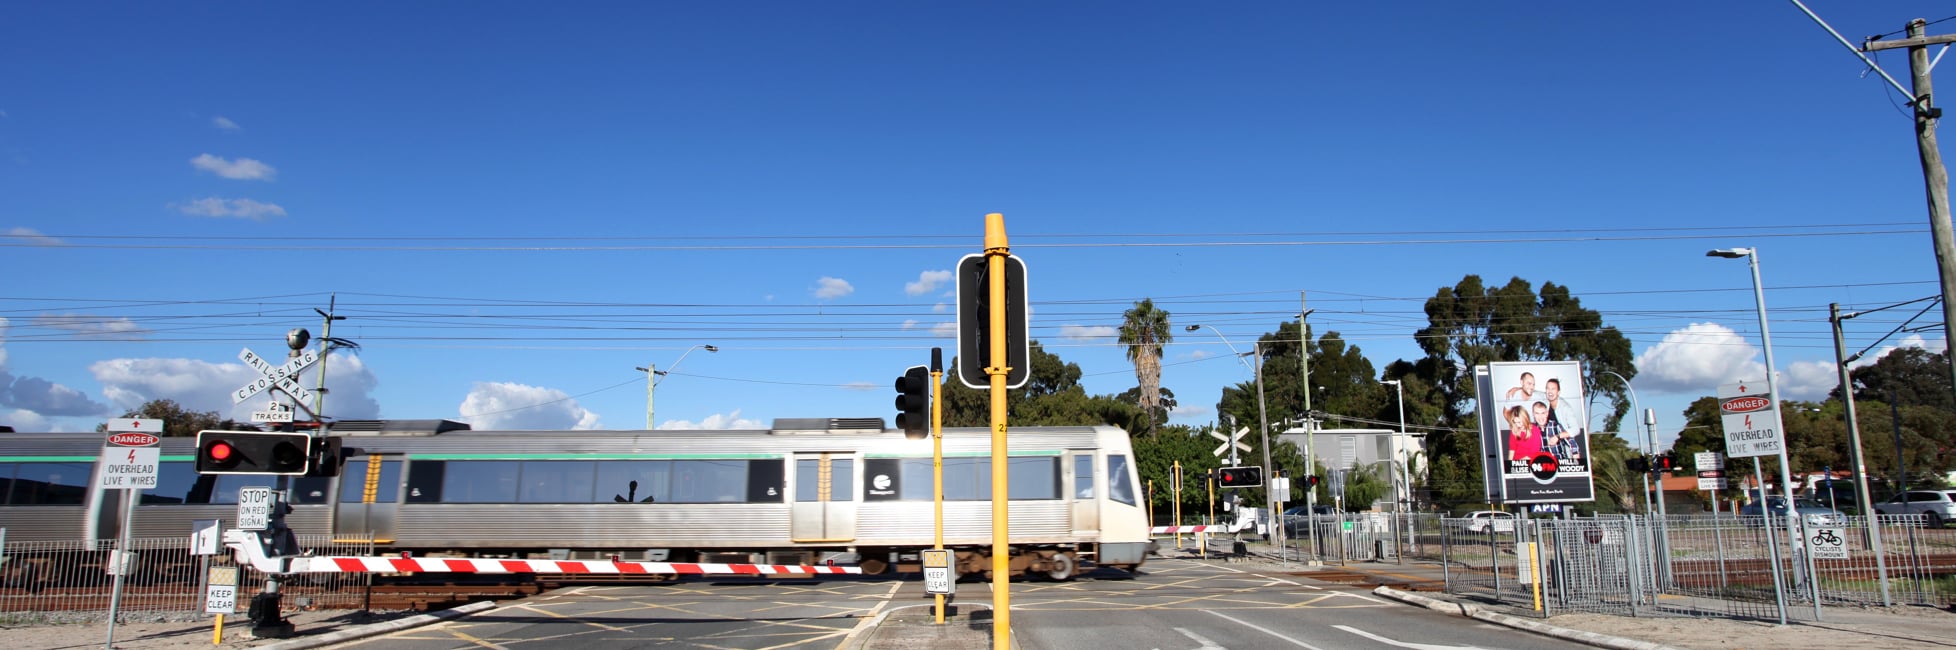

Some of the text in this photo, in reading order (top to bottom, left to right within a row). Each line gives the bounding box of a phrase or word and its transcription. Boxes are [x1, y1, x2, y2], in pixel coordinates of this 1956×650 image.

[238, 353, 312, 399] CROSSING
[270, 402, 277, 411] 2
[1726, 400, 1765, 410] DANGER
[114, 435, 154, 444] DANGER
[1729, 428, 1774, 442] OVERHEAD
[1728, 440, 1779, 455] LIVE WIRES
[108, 464, 154, 474] OVERHEAD
[1531, 463, 1555, 473] 96FM
[103, 476, 156, 486] LIVE WIRES
[241, 491, 268, 504] STOP
[241, 506, 266, 515] ON RED
[1534, 504, 1559, 512] APN
[240, 518, 265, 527] SIGNAL
[928, 571, 945, 579] KEEP
[927, 580, 948, 588] CLEAR
[210, 590, 232, 598] KEEP
[208, 600, 233, 609] CLEAR
